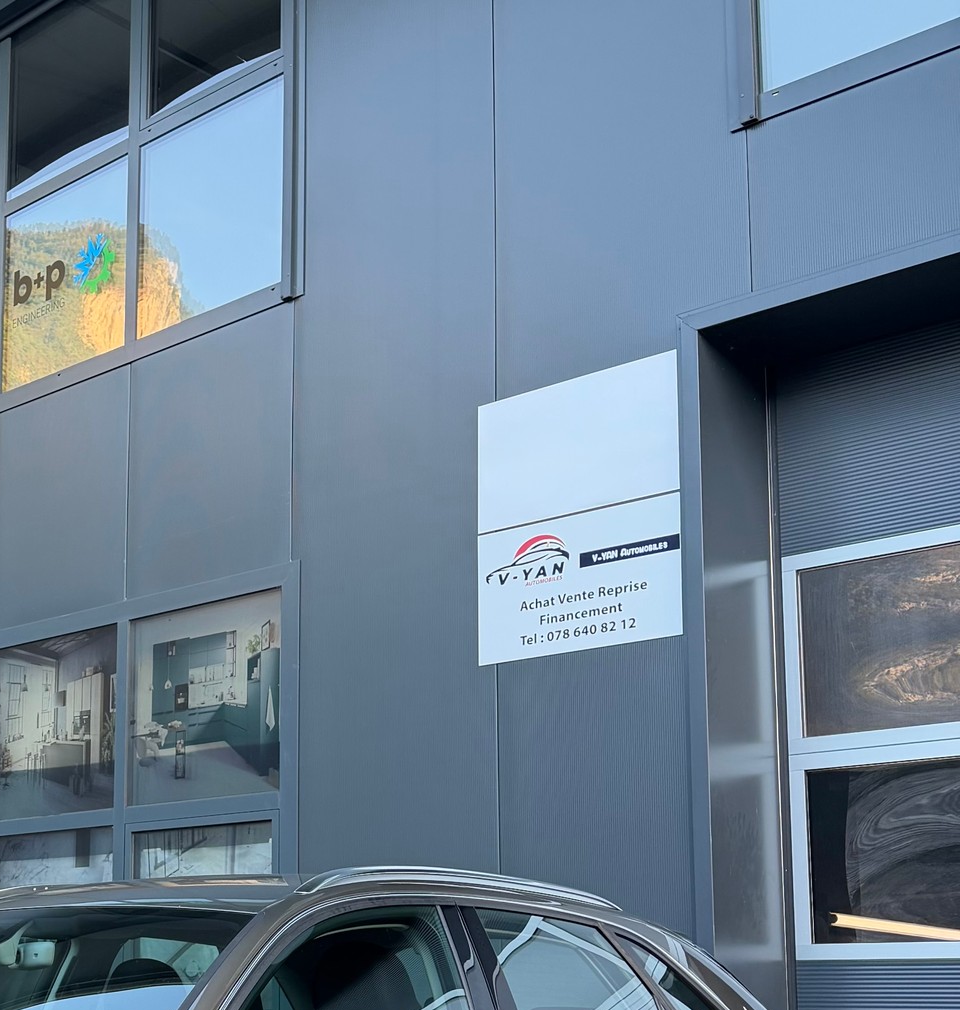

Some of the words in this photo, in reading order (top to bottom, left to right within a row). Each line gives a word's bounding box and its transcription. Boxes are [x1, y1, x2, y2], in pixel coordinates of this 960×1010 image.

[13, 259, 66, 307] b+p
[12, 298, 66, 329] ENGINEERING
[592, 550, 618, 562] V-YAN
[525, 575, 564, 587] AUTOMOBILES
[520, 598, 556, 612] Achat
[558, 590, 595, 605] Vente
[597, 580, 648, 598] Reprise
[539, 602, 623, 626] Financement
[546, 628, 570, 642] 078
[573, 624, 597, 638] 640
[600, 621, 617, 634] 82
[621, 617, 637, 630] 12
